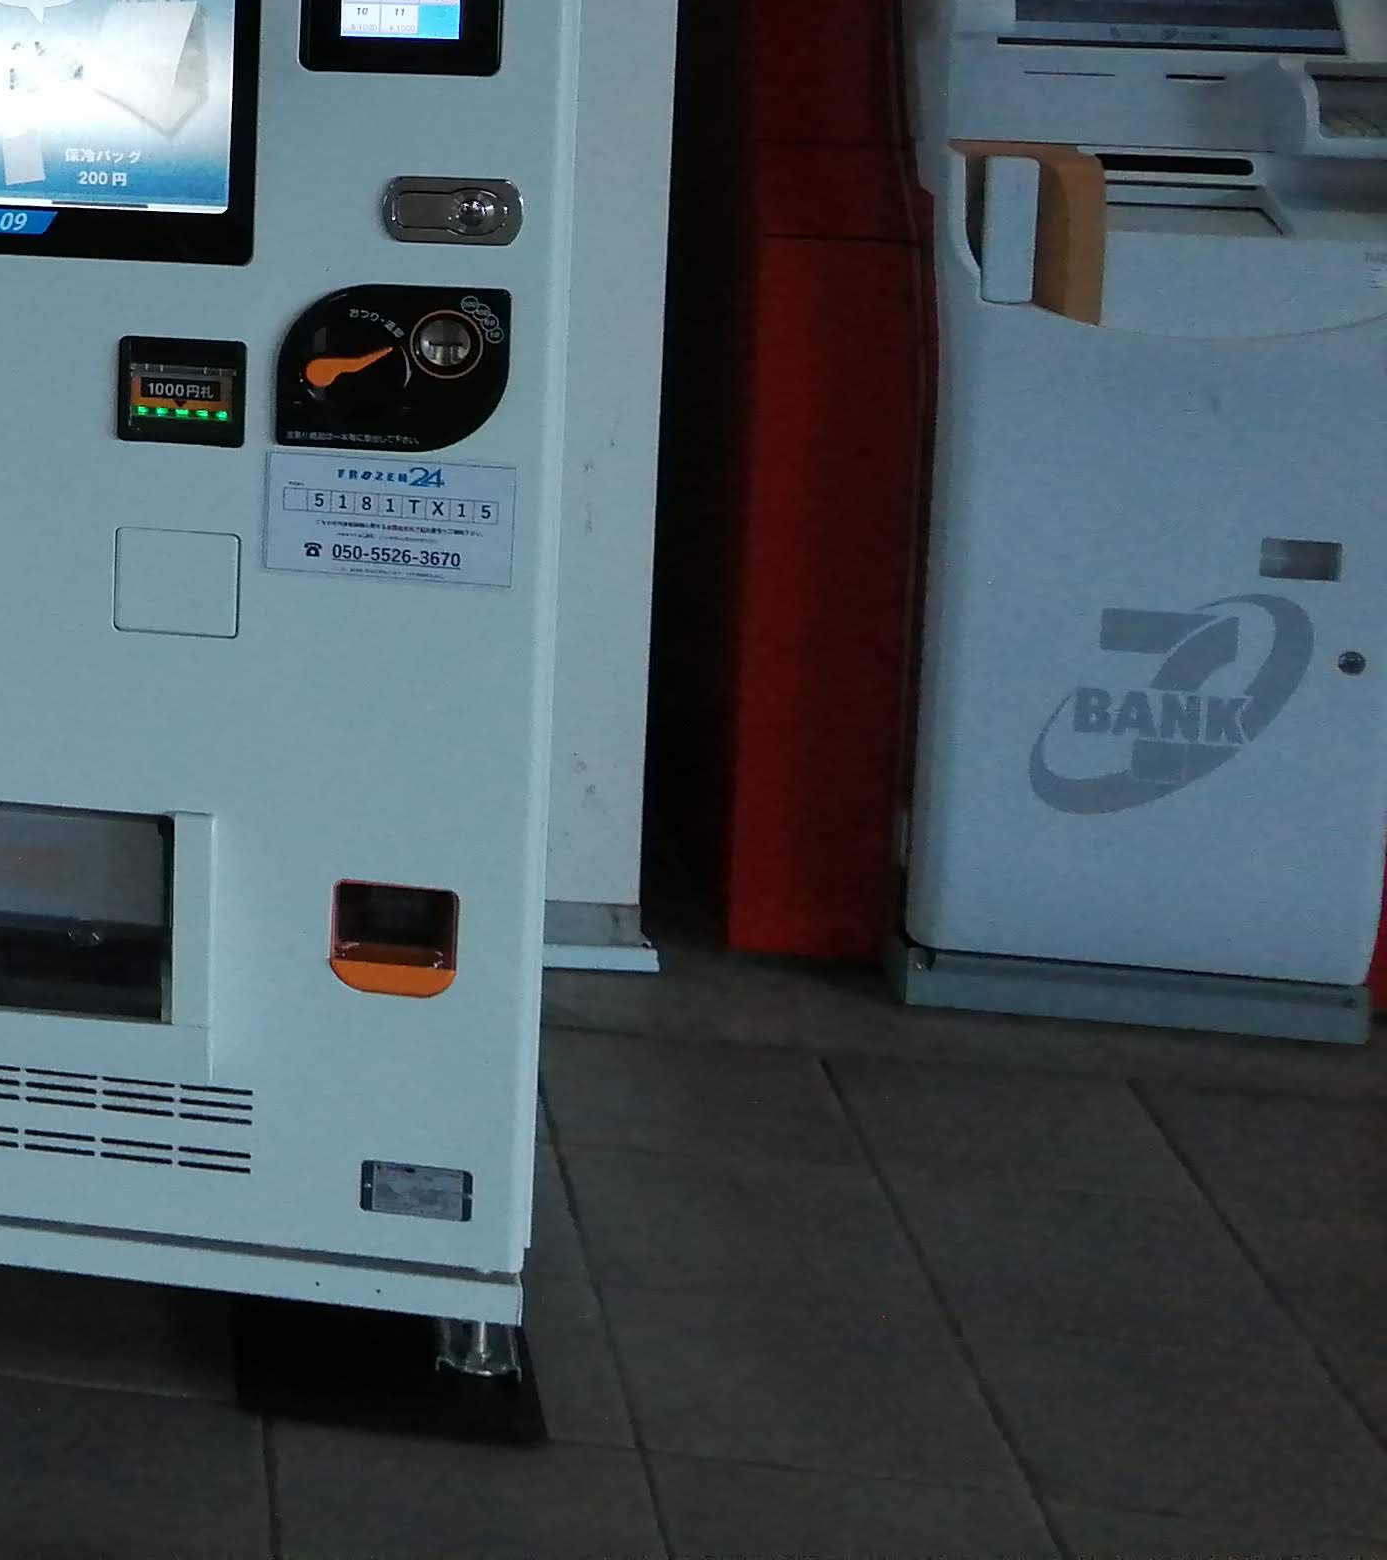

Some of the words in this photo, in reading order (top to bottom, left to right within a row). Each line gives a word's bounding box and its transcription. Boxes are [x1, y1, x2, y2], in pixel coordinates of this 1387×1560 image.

[356, 7, 369, 17] 10
[394, 7, 406, 17] 11
[64, 147, 142, 165] 保冷バッグ
[78, 171, 129, 187] 200円
[146, 382, 215, 400] 1000円札
[331, 542, 462, 568] 050-5526-3670
[1072, 687, 1251, 744] BANK
